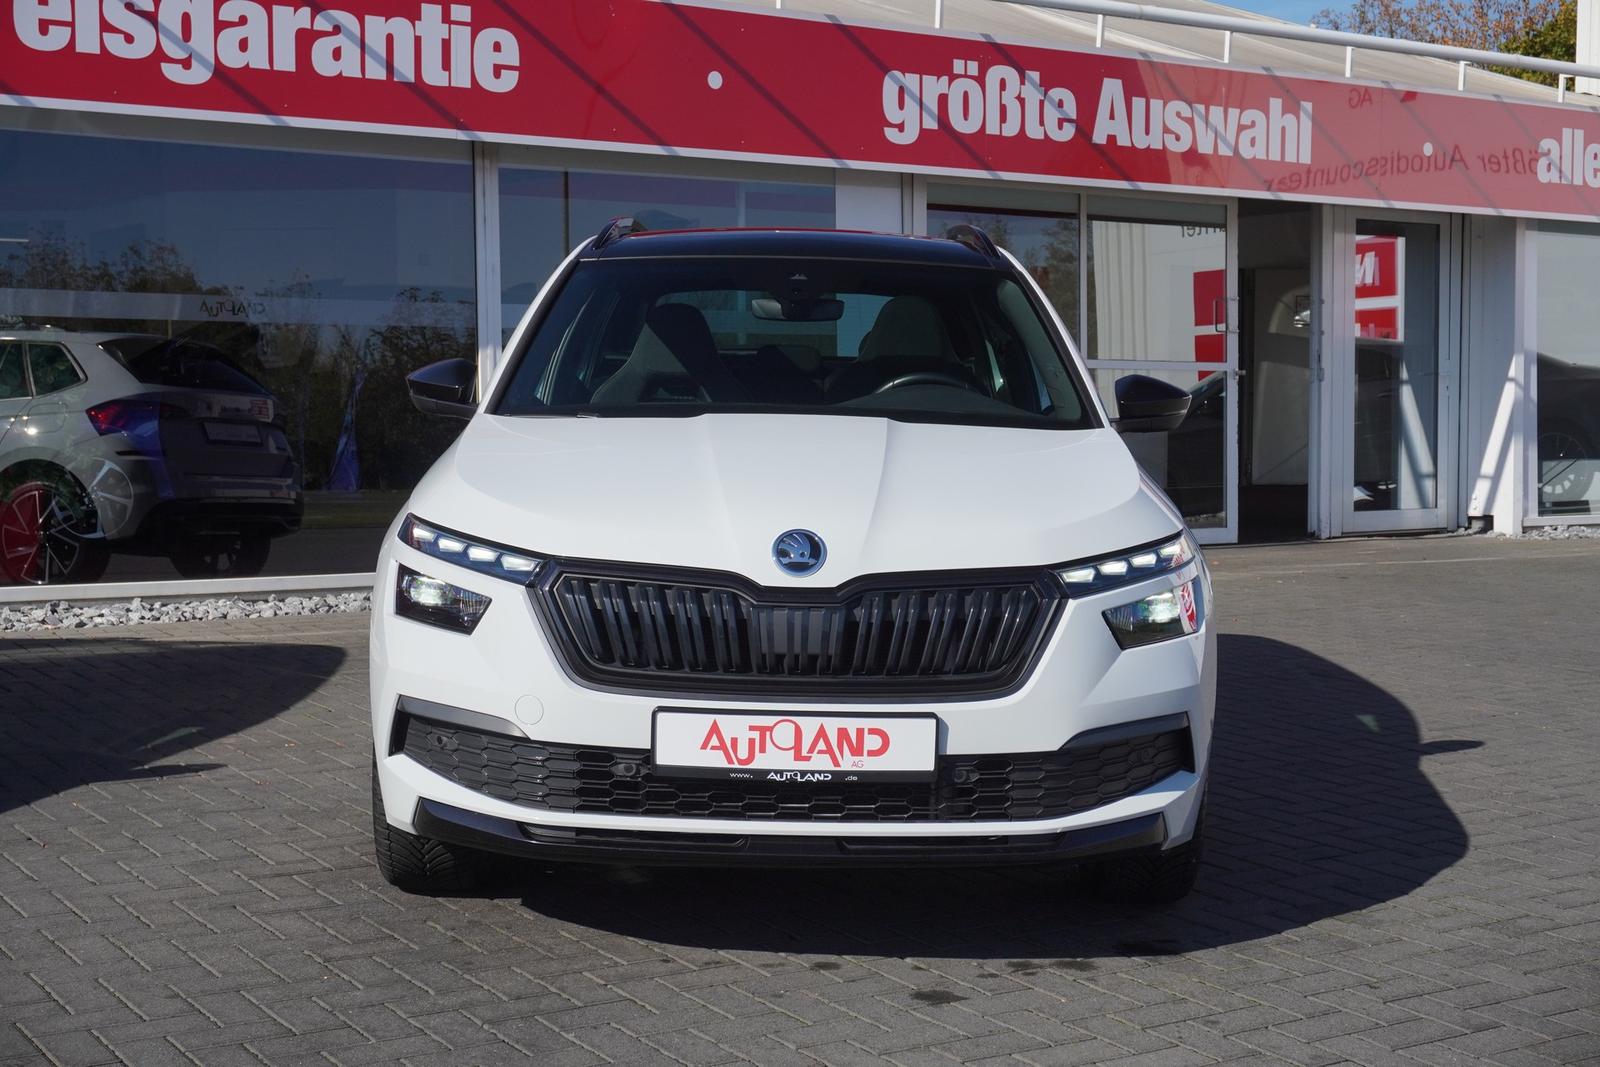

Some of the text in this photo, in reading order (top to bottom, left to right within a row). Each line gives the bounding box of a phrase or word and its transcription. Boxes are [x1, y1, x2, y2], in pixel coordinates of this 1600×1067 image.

[882, 59, 1312, 164] größte Auswahl
[1536, 127, 1600, 188] alle
[700, 718, 890, 768] AUTOLAND
[851, 760, 864, 768] AG
[766, 770, 832, 782] AUTOLAND
